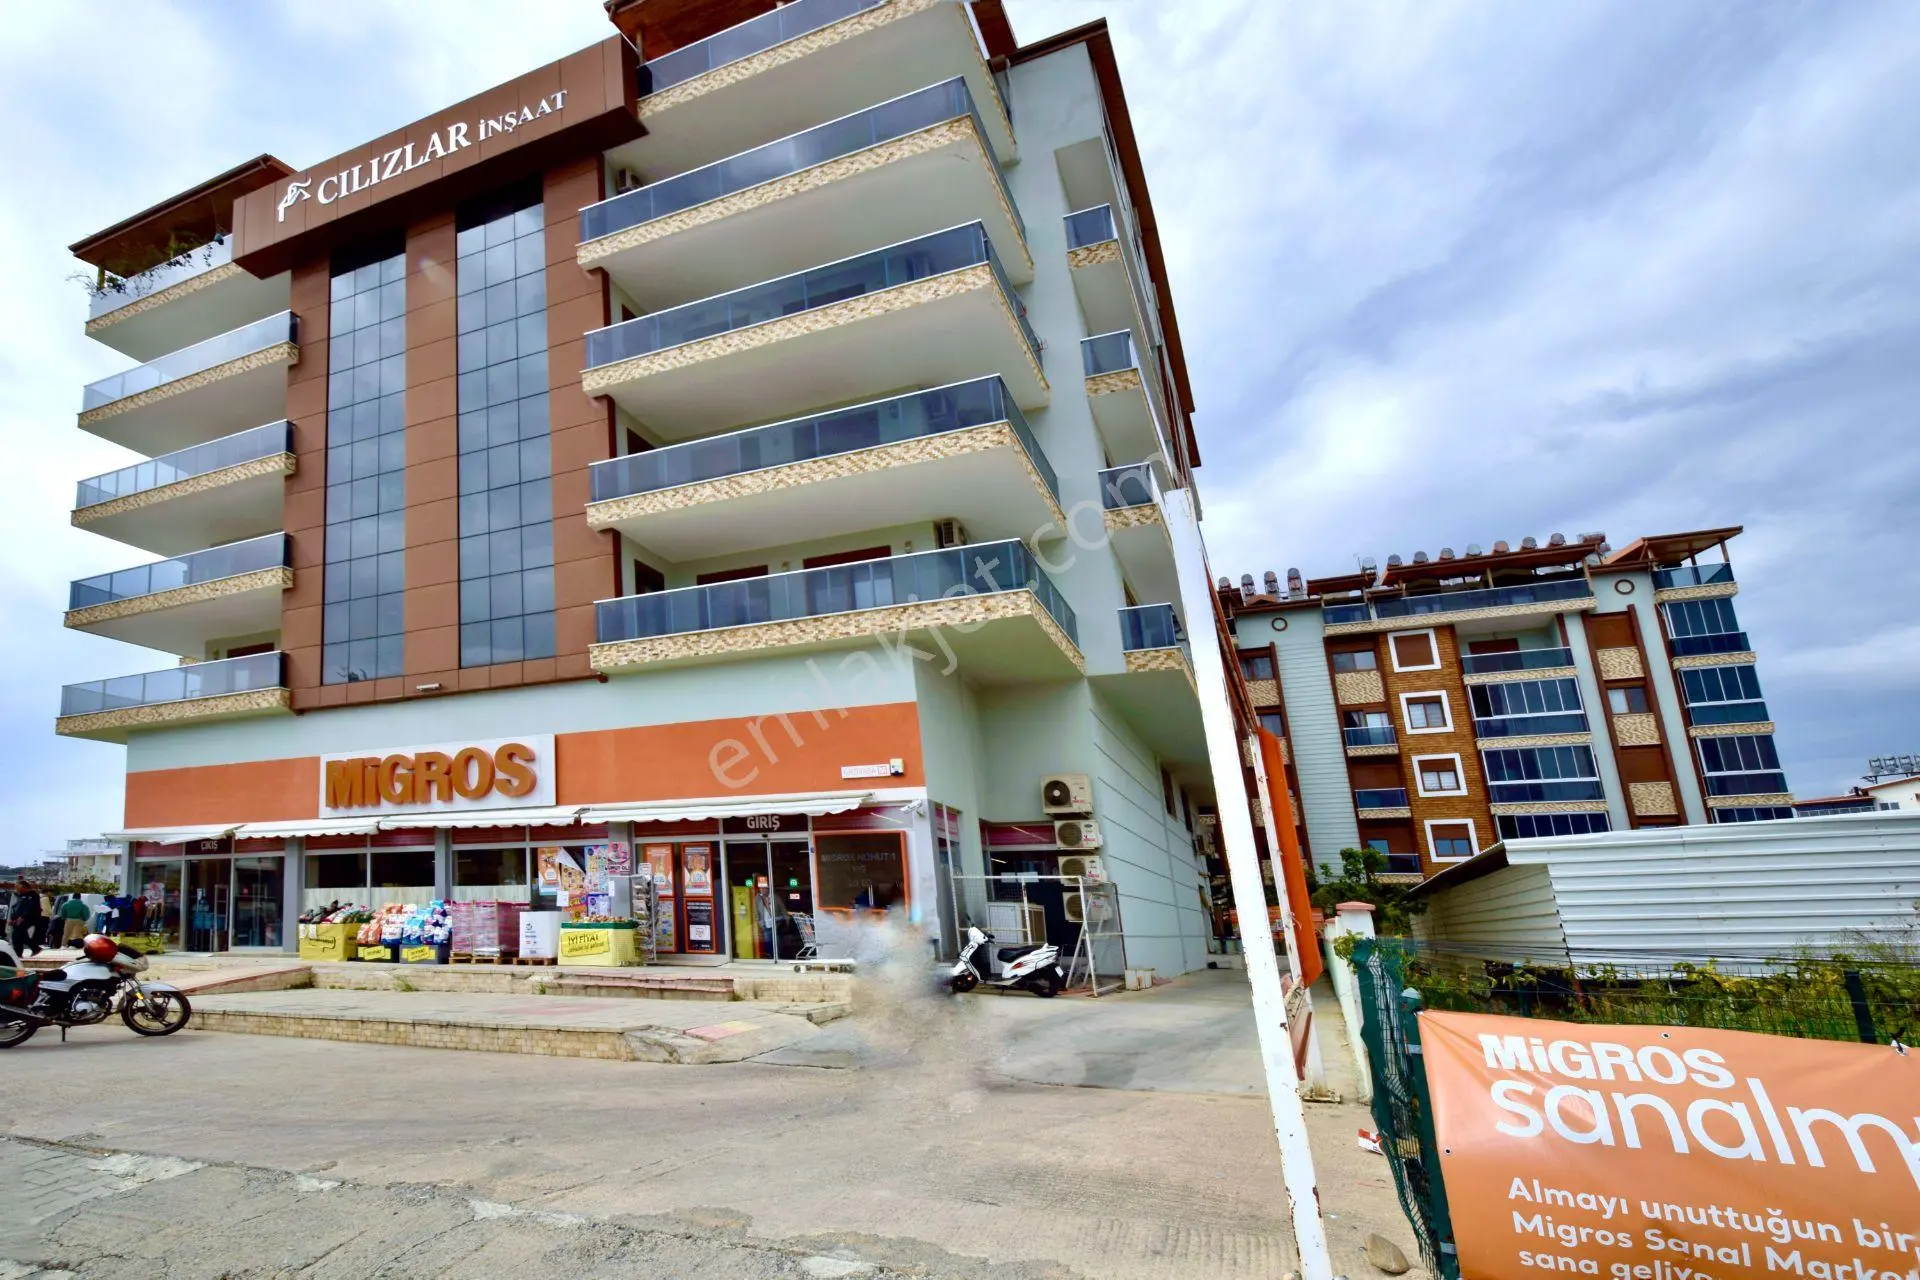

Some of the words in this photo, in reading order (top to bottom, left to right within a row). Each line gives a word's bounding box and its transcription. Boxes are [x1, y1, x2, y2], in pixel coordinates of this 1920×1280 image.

[317, 121, 471, 204] CILIZLAR
[478, 90, 568, 141] İNŞAAT
[1490, 1078, 1920, 1191] sanalm
[1507, 1176, 1629, 1219] Almayı
[1640, 1198, 1842, 1244] unuttuğun
[1512, 1210, 1633, 1247] Migros
[1645, 1228, 1752, 1267] Sanal
[1518, 1248, 1600, 1275] sana
